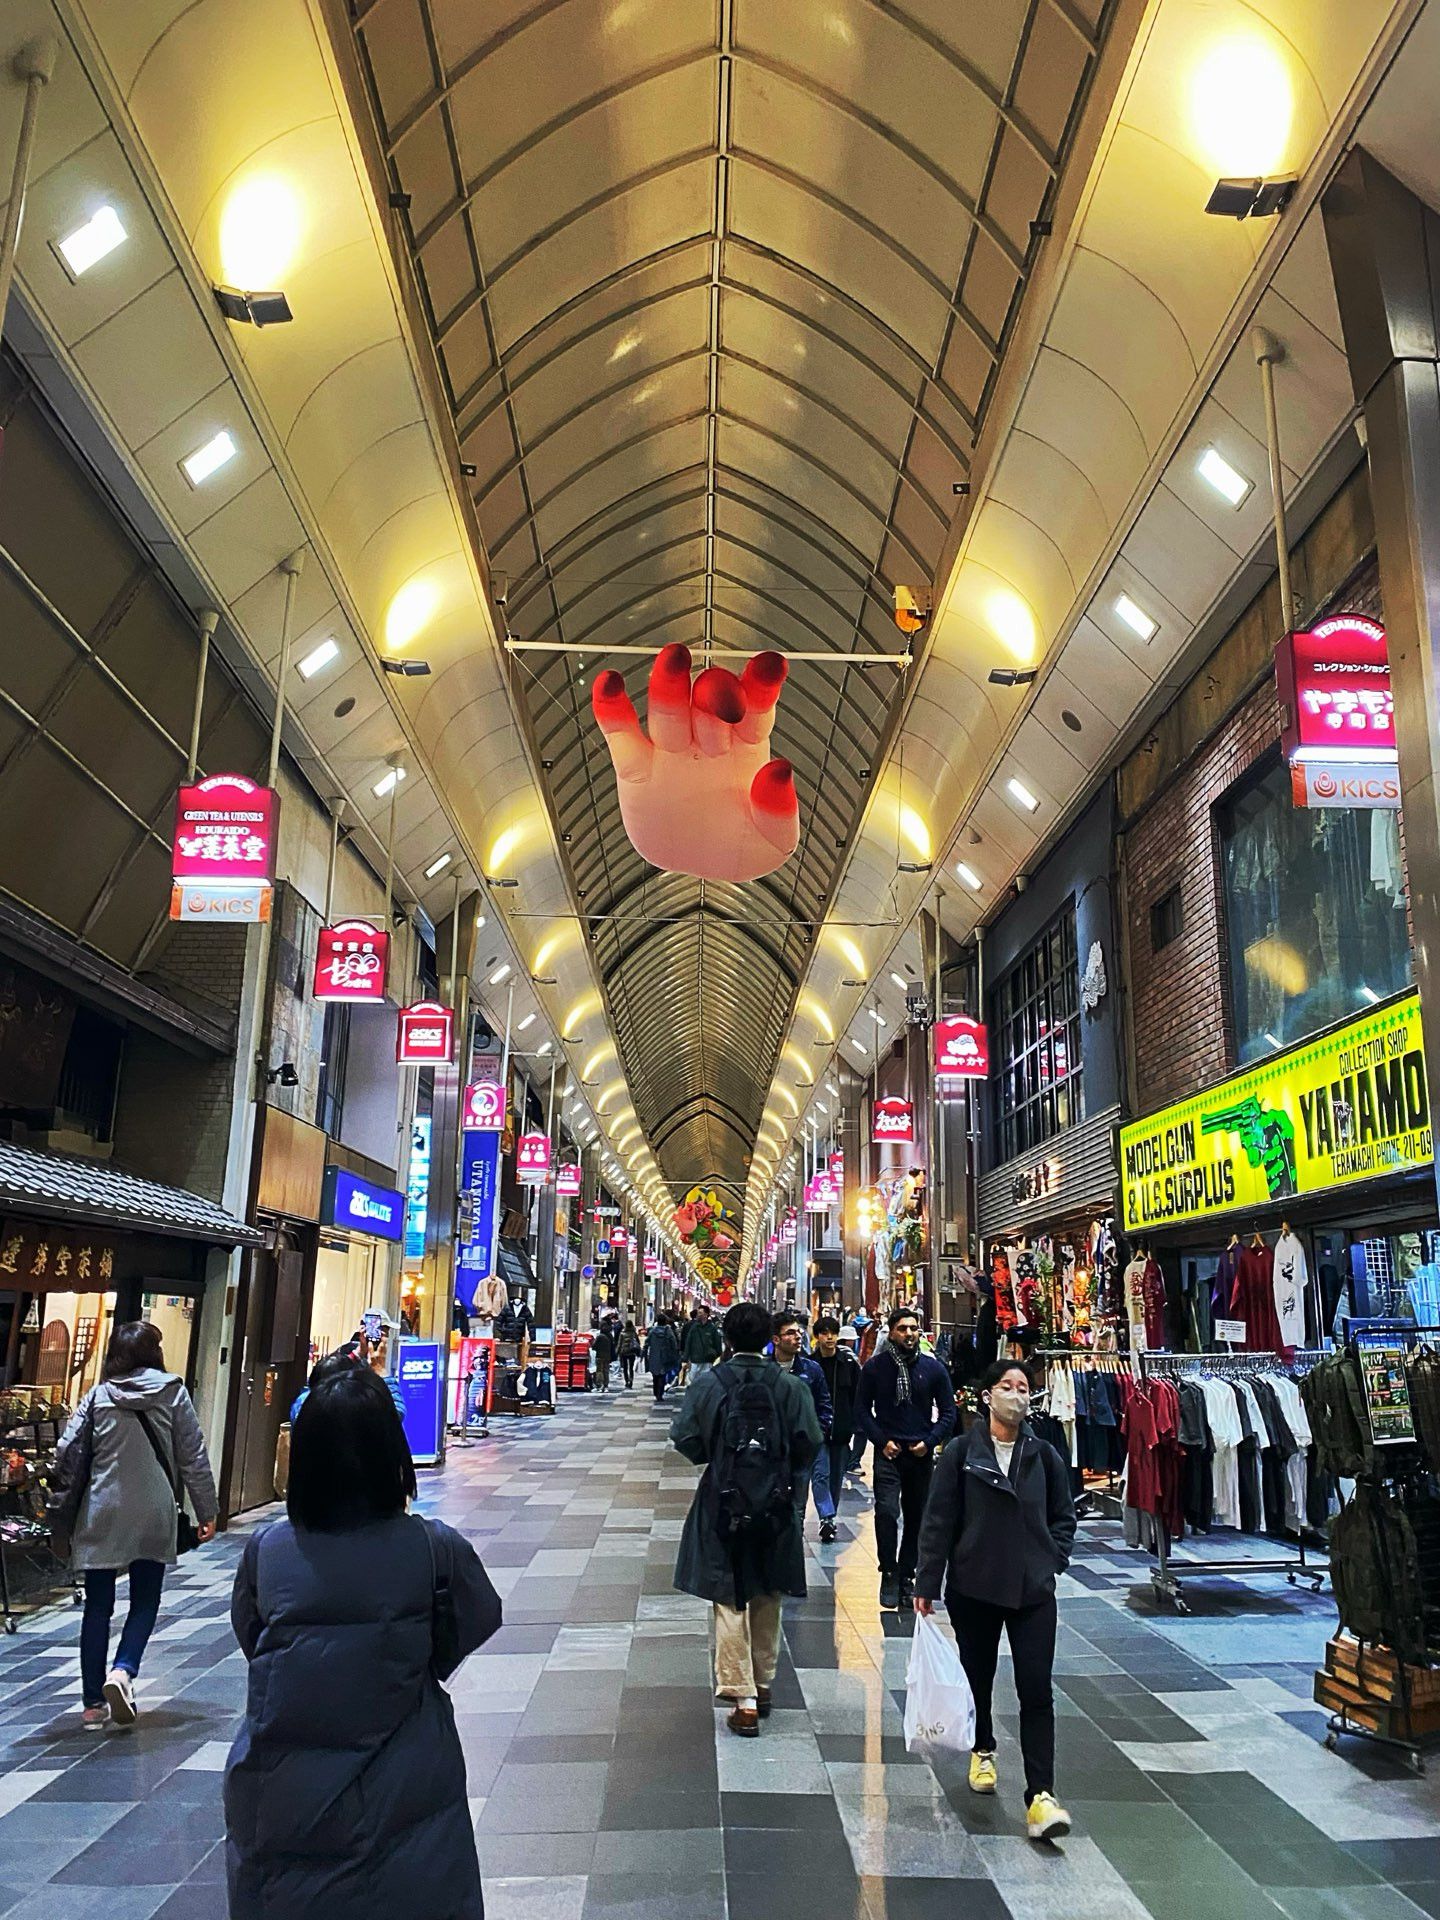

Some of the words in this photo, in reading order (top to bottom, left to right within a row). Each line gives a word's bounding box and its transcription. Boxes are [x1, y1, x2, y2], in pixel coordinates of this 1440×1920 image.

[1313, 619, 1385, 642] TERAMACHI
[1341, 780, 1399, 799] KICS
[184, 811, 207, 822] GREEN
[208, 811, 223, 822] TEA
[230, 812, 264, 822] UTENSILS
[195, 825, 250, 835] HOURAIDO
[208, 898, 254, 915] KICS
[1338, 1035, 1386, 1076] COLLECTION
[1387, 1027, 1409, 1057] SHOP
[1330, 1145, 1375, 1179] TERAMACHI
[1128, 1188, 1139, 1225] &
[471, 1414, 485, 1426] 2F
